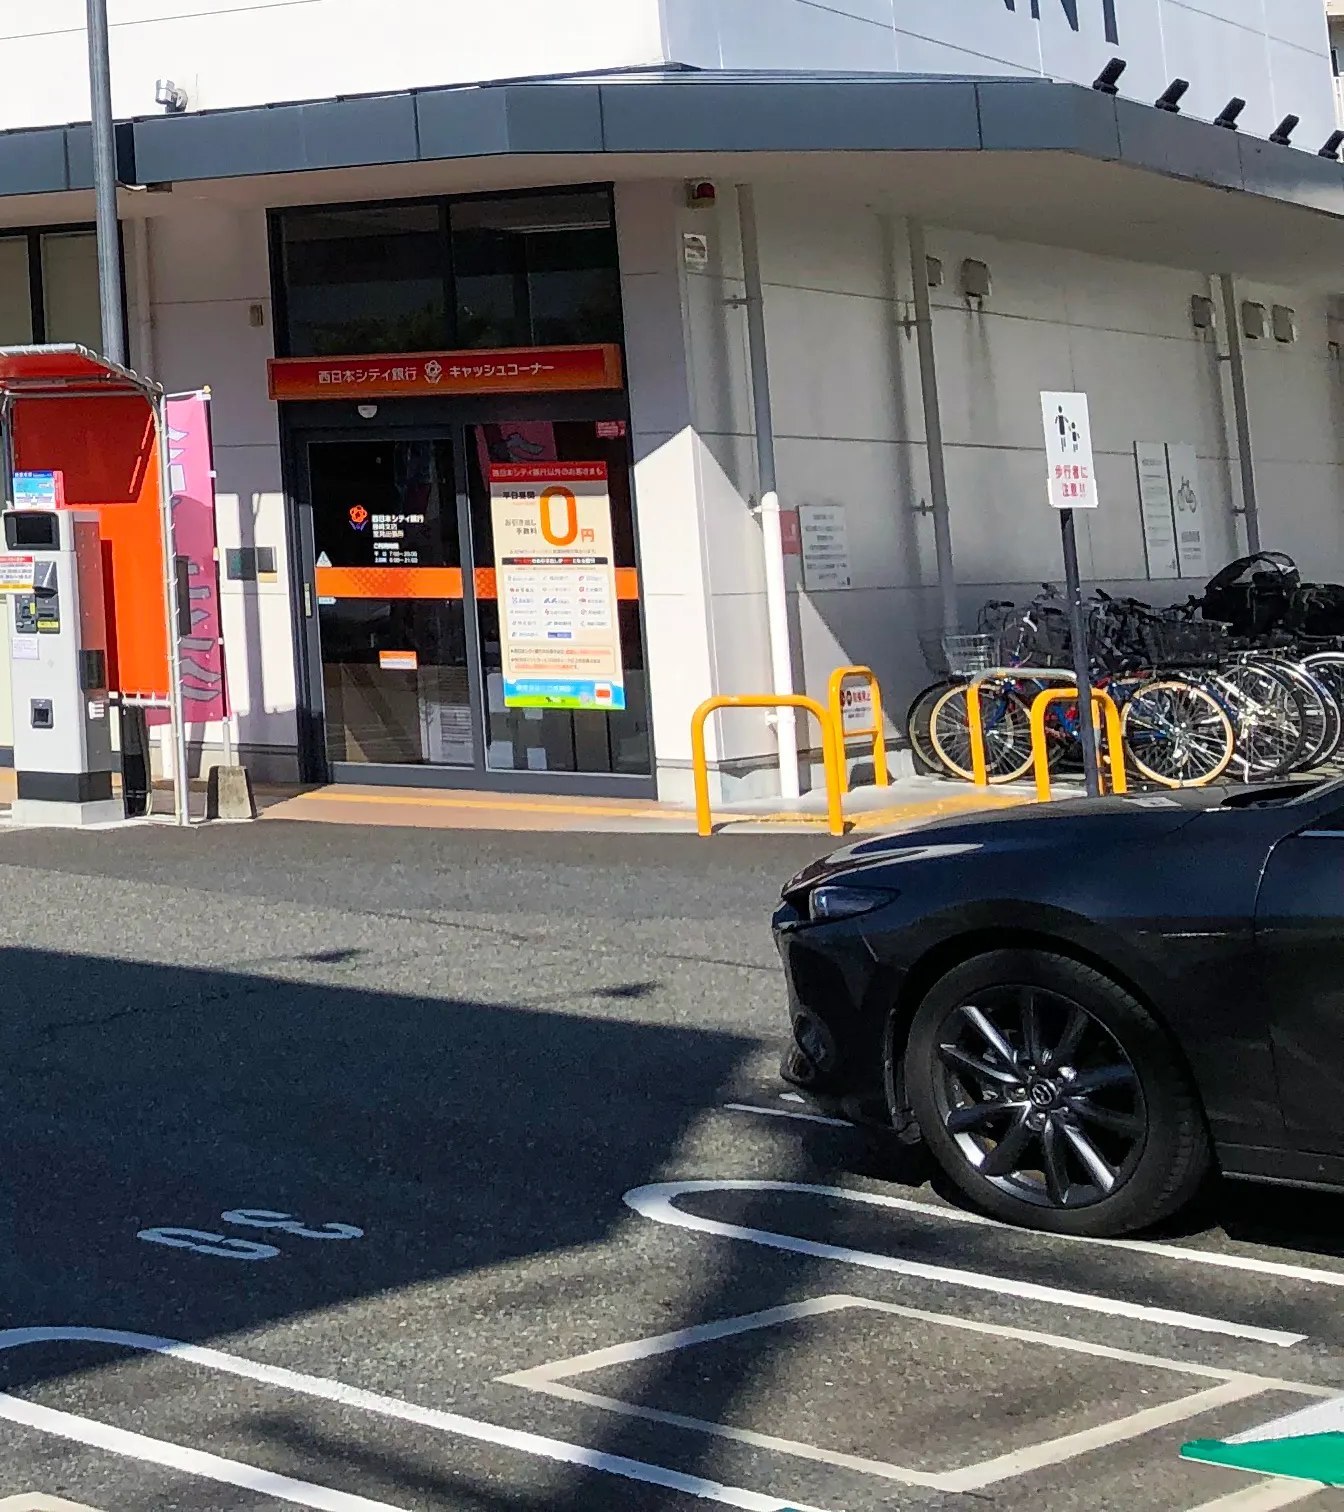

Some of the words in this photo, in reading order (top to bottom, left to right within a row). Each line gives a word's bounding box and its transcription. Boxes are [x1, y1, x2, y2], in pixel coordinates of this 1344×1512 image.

[318, 367, 417, 384] 西日本シティ銀行
[449, 363, 555, 378] キャッシュコーナー
[581, 528, 595, 542] 円
[136, 1208, 364, 1260] 30
